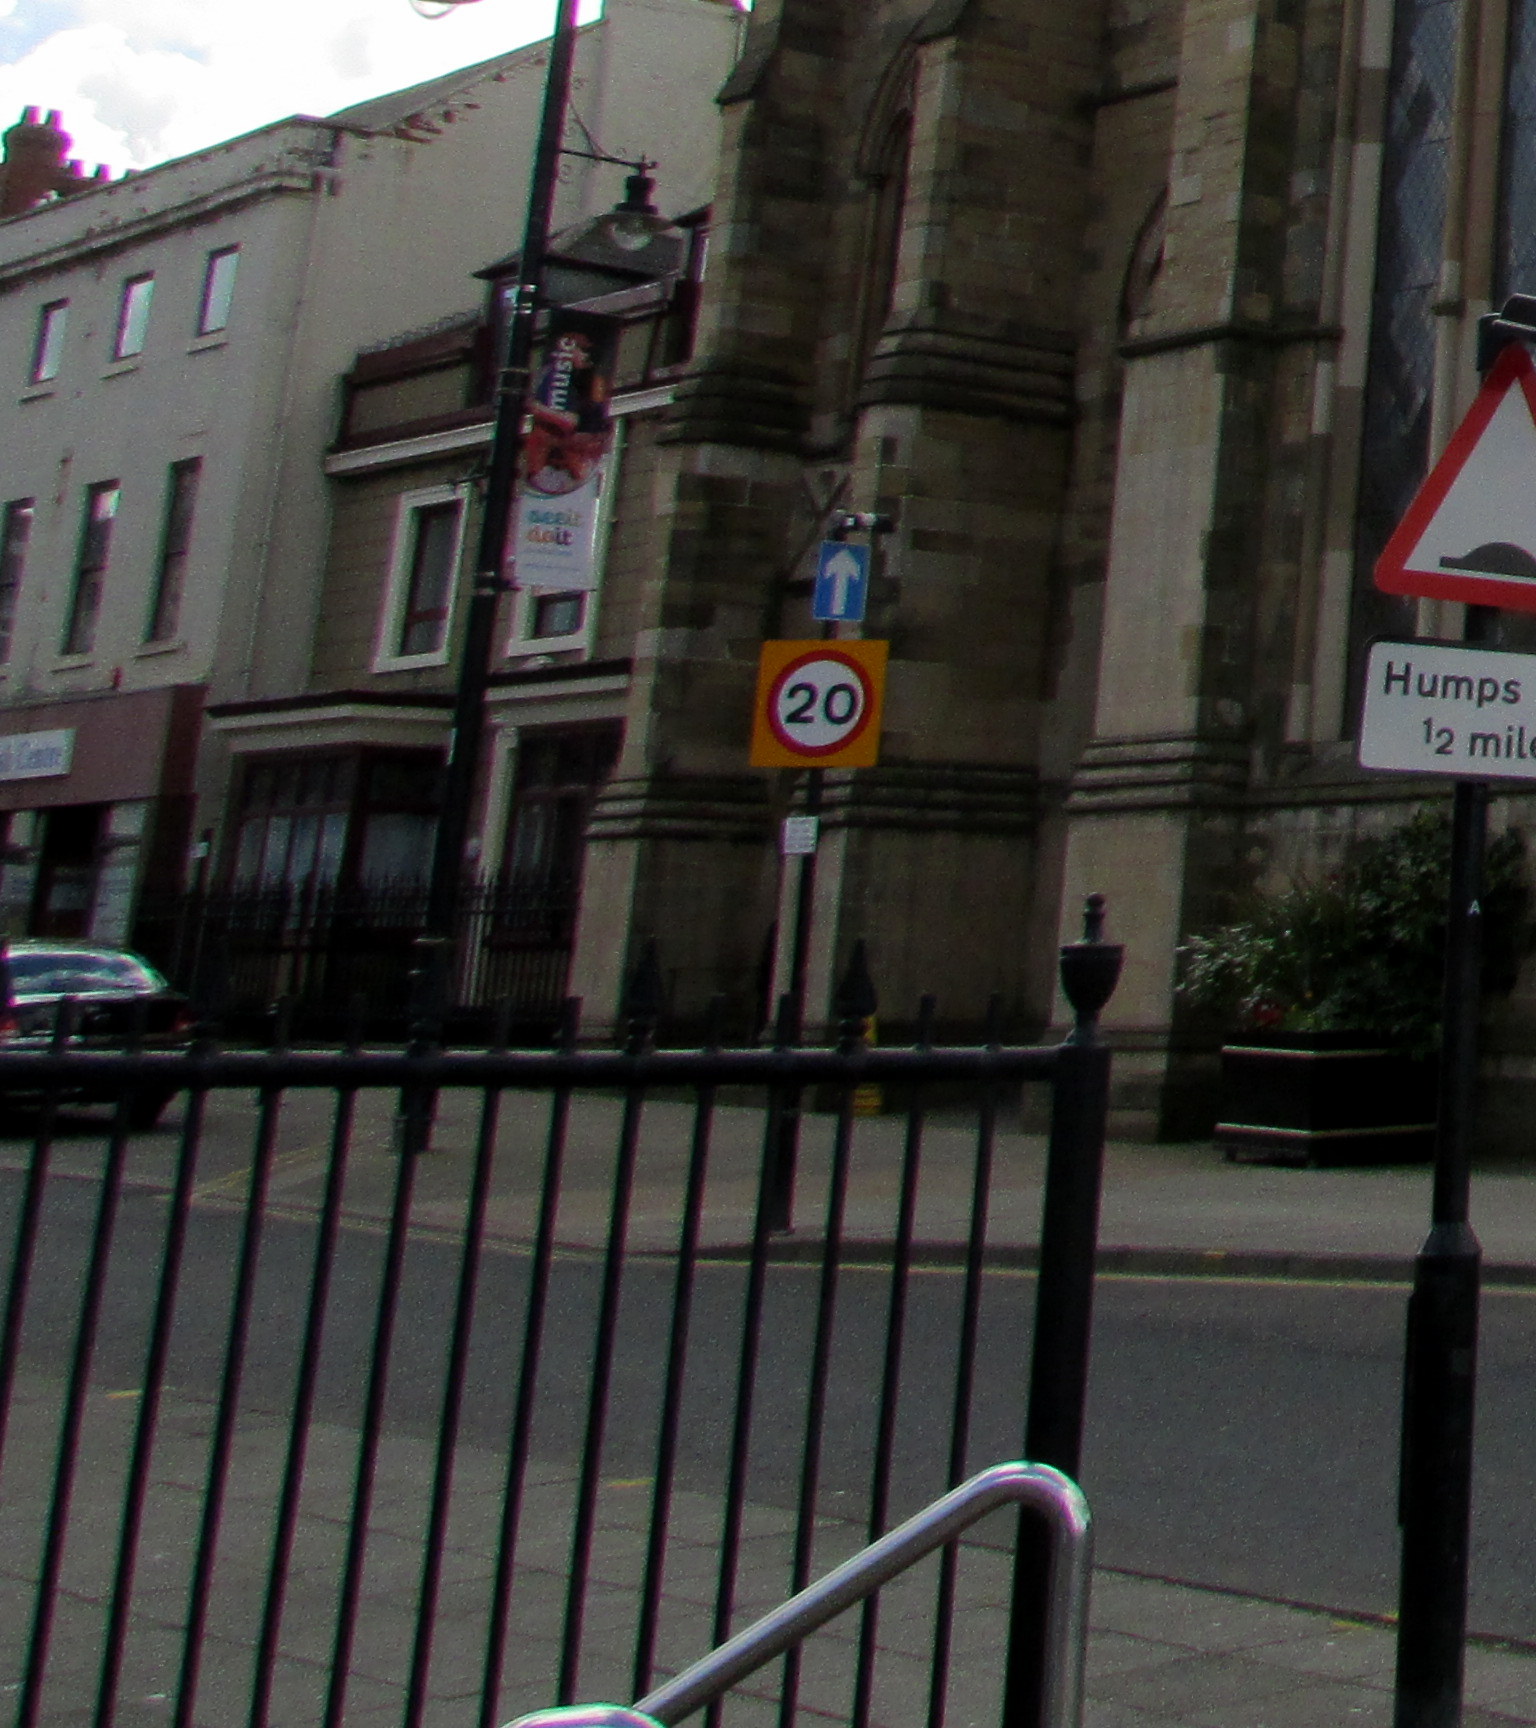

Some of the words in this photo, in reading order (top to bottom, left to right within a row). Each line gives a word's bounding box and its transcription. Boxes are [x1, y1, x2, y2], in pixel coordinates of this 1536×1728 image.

[550, 335, 578, 411] music
[784, 681, 860, 726] 20
[1383, 659, 1522, 708] Humps
